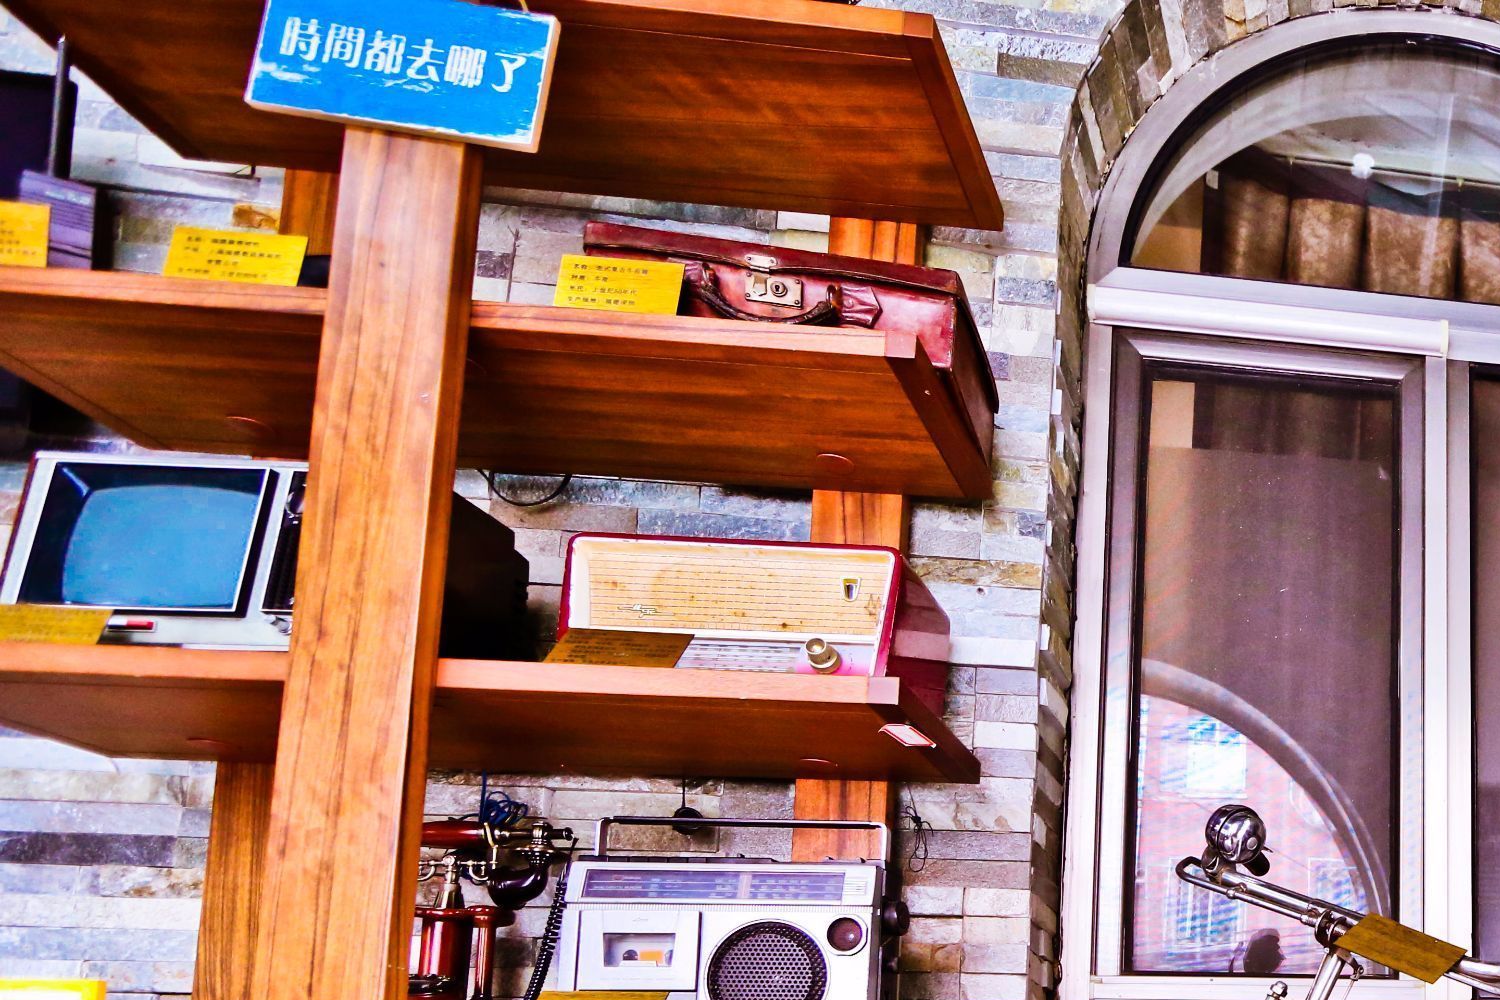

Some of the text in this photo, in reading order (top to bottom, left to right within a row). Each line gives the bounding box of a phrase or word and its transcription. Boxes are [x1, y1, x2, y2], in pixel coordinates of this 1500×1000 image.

[279, 16, 528, 93] 時間都去哪了
